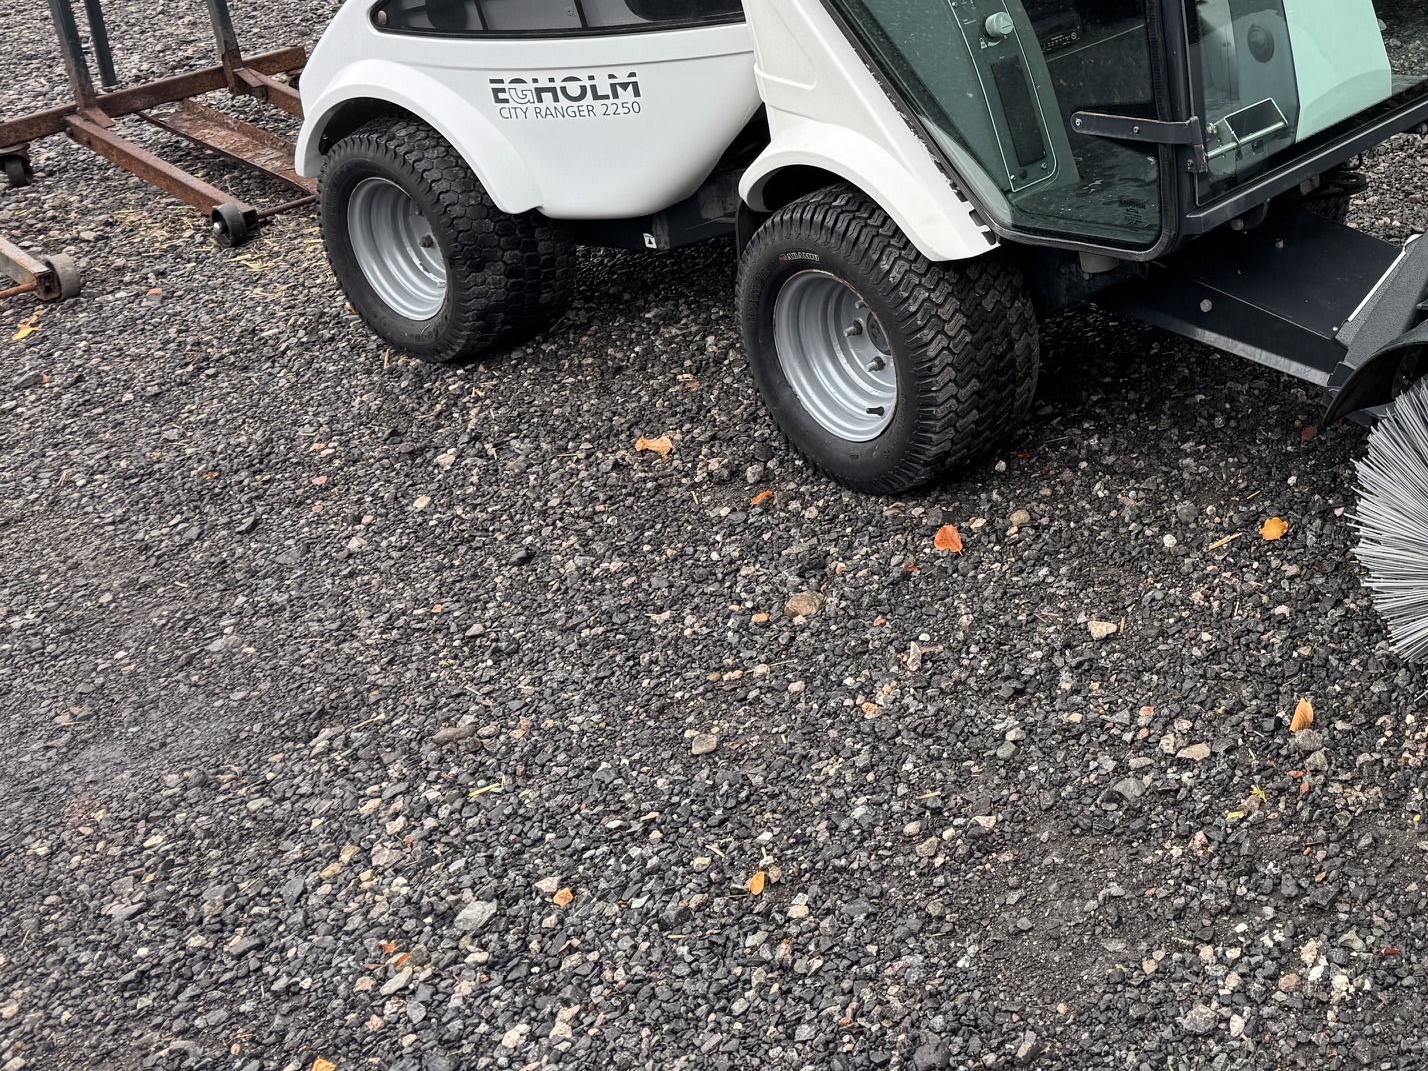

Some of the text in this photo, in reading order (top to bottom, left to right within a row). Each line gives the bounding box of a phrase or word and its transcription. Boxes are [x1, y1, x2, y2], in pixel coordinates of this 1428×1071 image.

[488, 72, 642, 105] EGHOLM
[499, 101, 641, 120] CITY RANGER 2250
